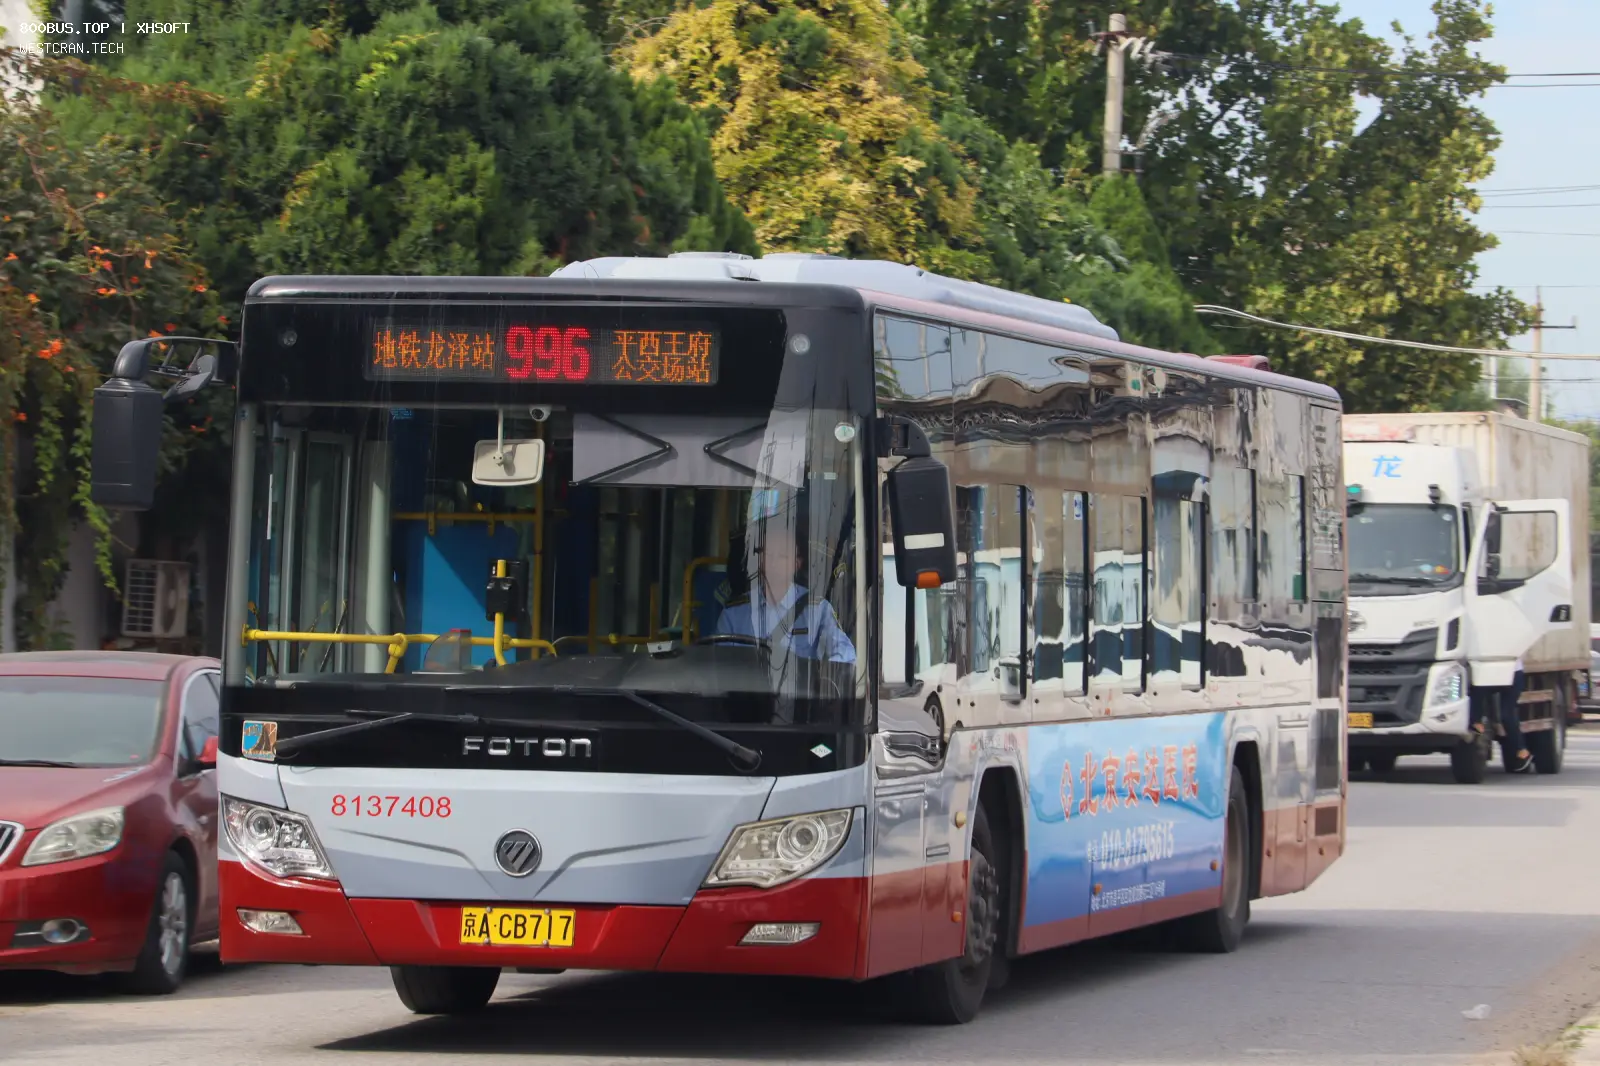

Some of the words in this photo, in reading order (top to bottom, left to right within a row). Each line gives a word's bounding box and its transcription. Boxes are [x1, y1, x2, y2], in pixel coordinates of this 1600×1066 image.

[373, 329, 495, 369] 地铁龙泽站
[505, 326, 591, 380] 996
[612, 330, 713, 357] 平西王府
[612, 355, 712, 384] 公交场站
[1372, 454, 1403, 479] 龙
[462, 735, 592, 757] FOTON
[1078, 740, 1199, 816] 北京安达医院
[330, 794, 452, 818] 8137408
